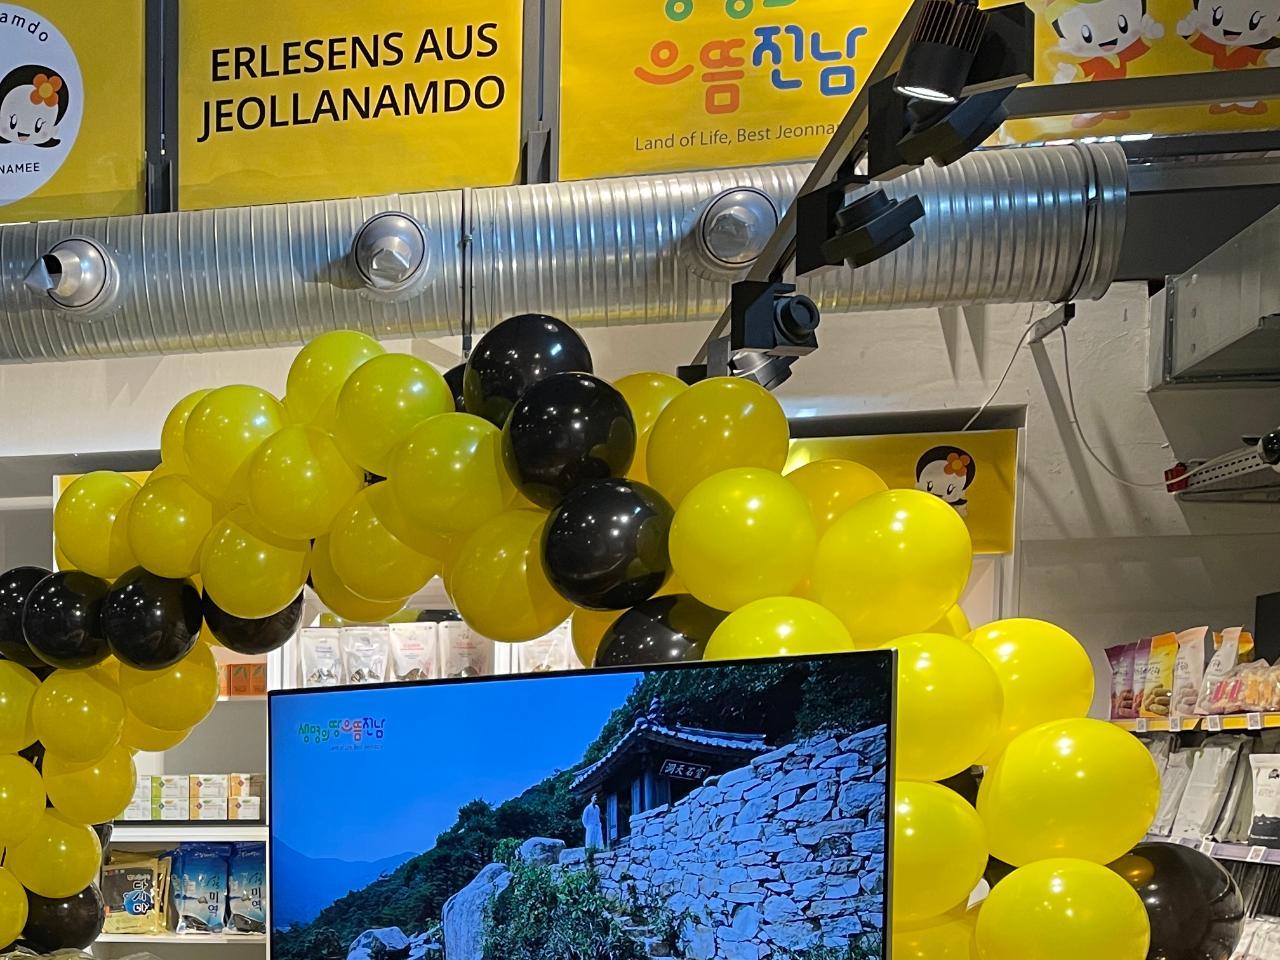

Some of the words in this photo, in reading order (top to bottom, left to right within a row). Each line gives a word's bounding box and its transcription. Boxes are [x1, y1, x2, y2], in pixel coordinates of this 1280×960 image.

[211, 30, 404, 82] ERLESENS
[414, 22, 499, 64] AUS
[197, 74, 506, 144] JEOLLANAMDO
[635, 134, 675, 152] Land
[679, 130, 697, 148] of
[700, 128, 732, 146] Life,
[737, 126, 772, 143] Best
[775, 121, 842, 141] Jeonna
